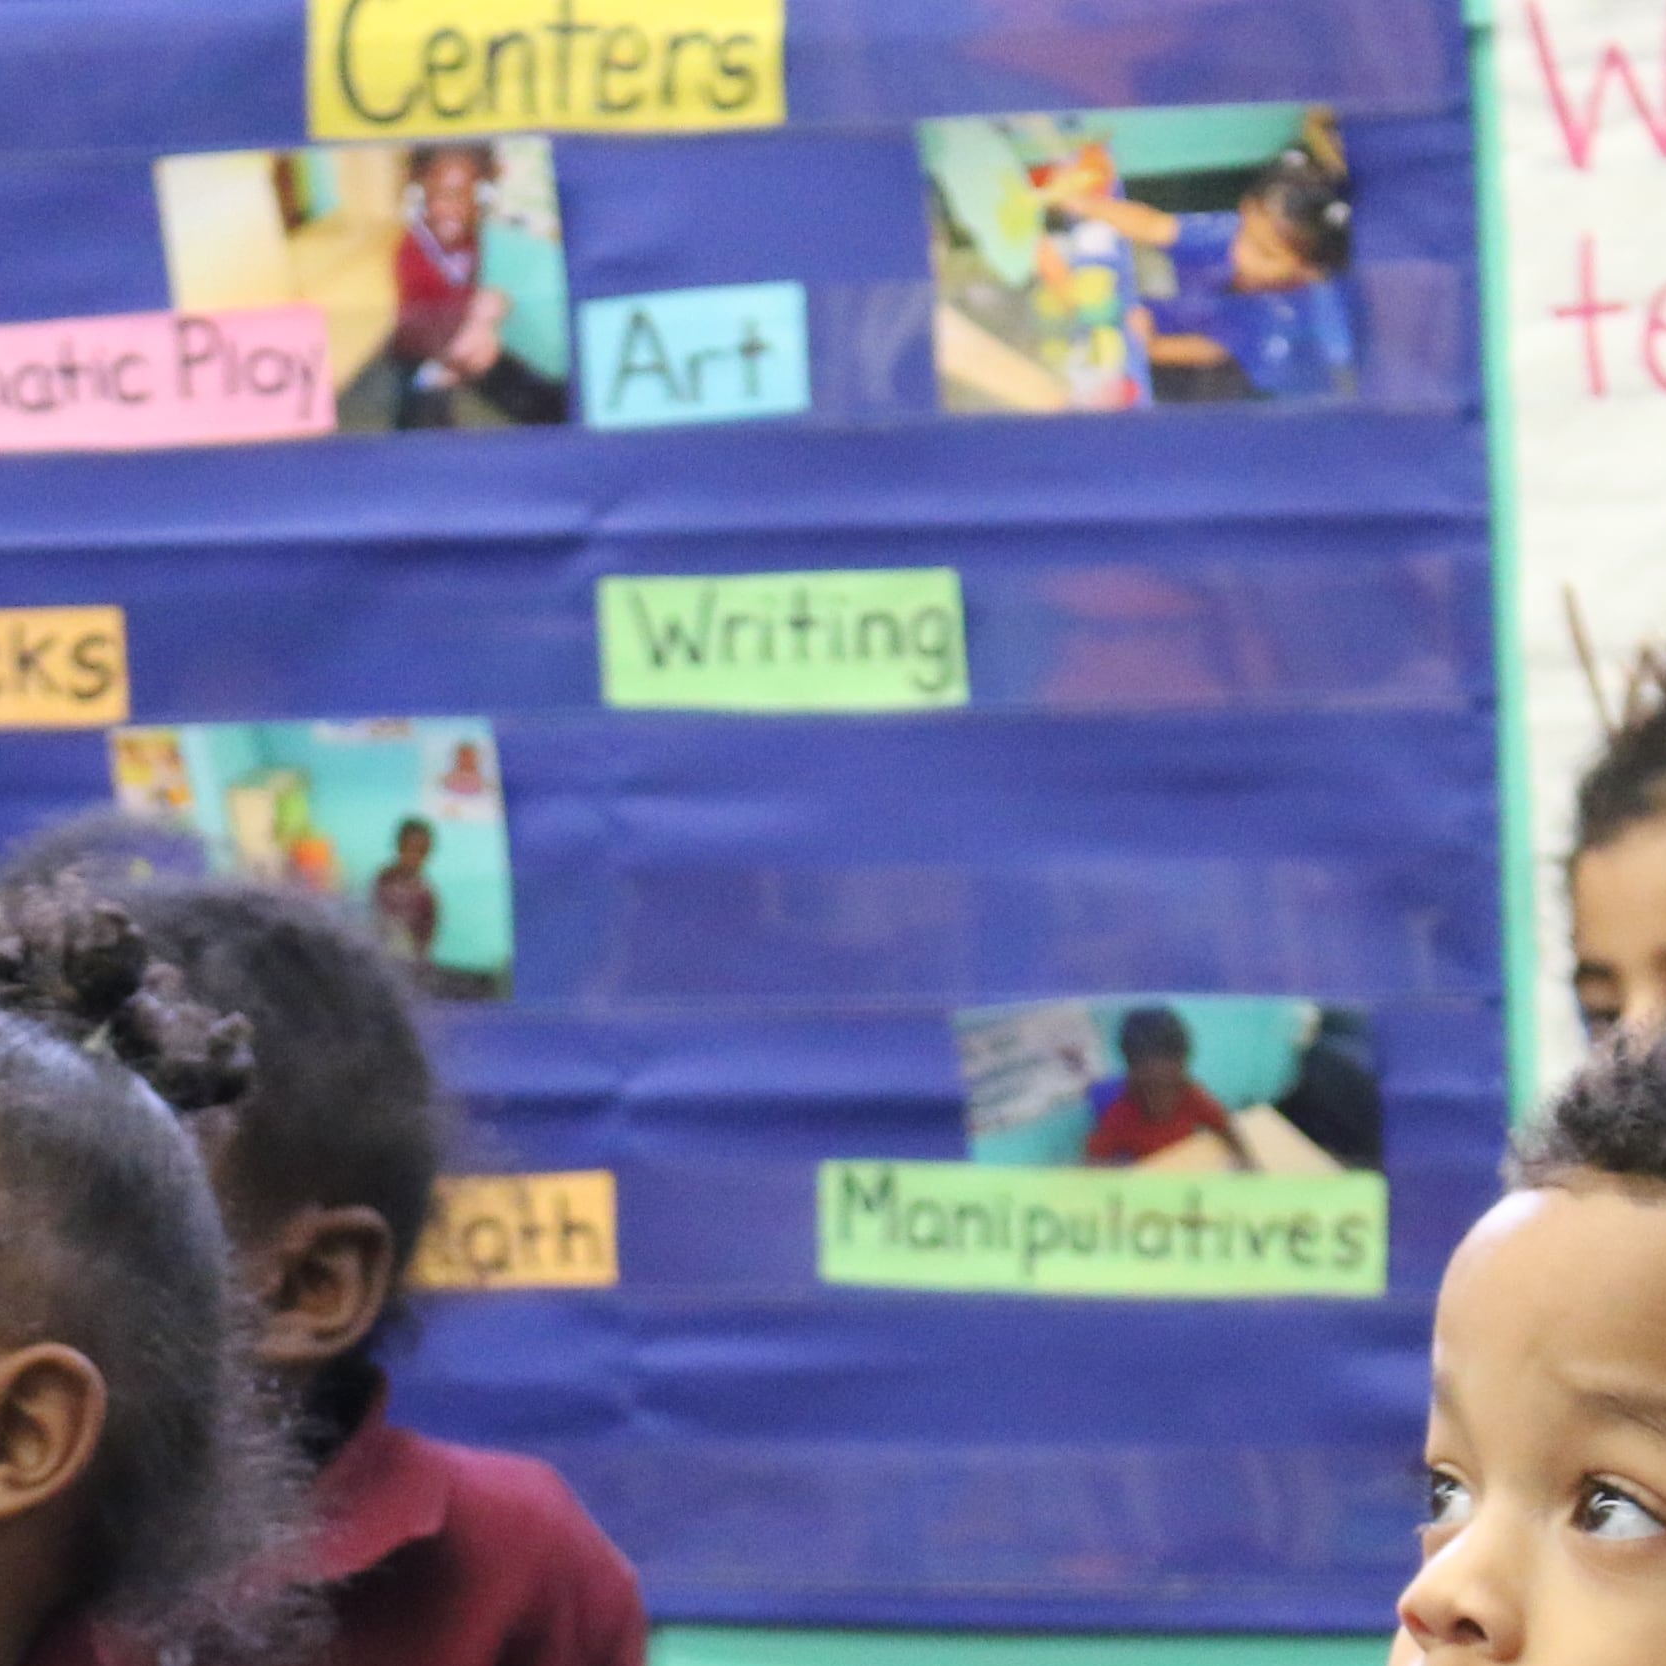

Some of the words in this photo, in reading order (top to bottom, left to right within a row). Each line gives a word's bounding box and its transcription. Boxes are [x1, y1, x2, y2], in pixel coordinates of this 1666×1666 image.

[338, 0, 761, 127] Centers
[173, 316, 323, 421] Play
[607, 310, 772, 410] Art
[627, 590, 960, 692] Writing
[833, 1165, 1373, 1274] Manipulatives
